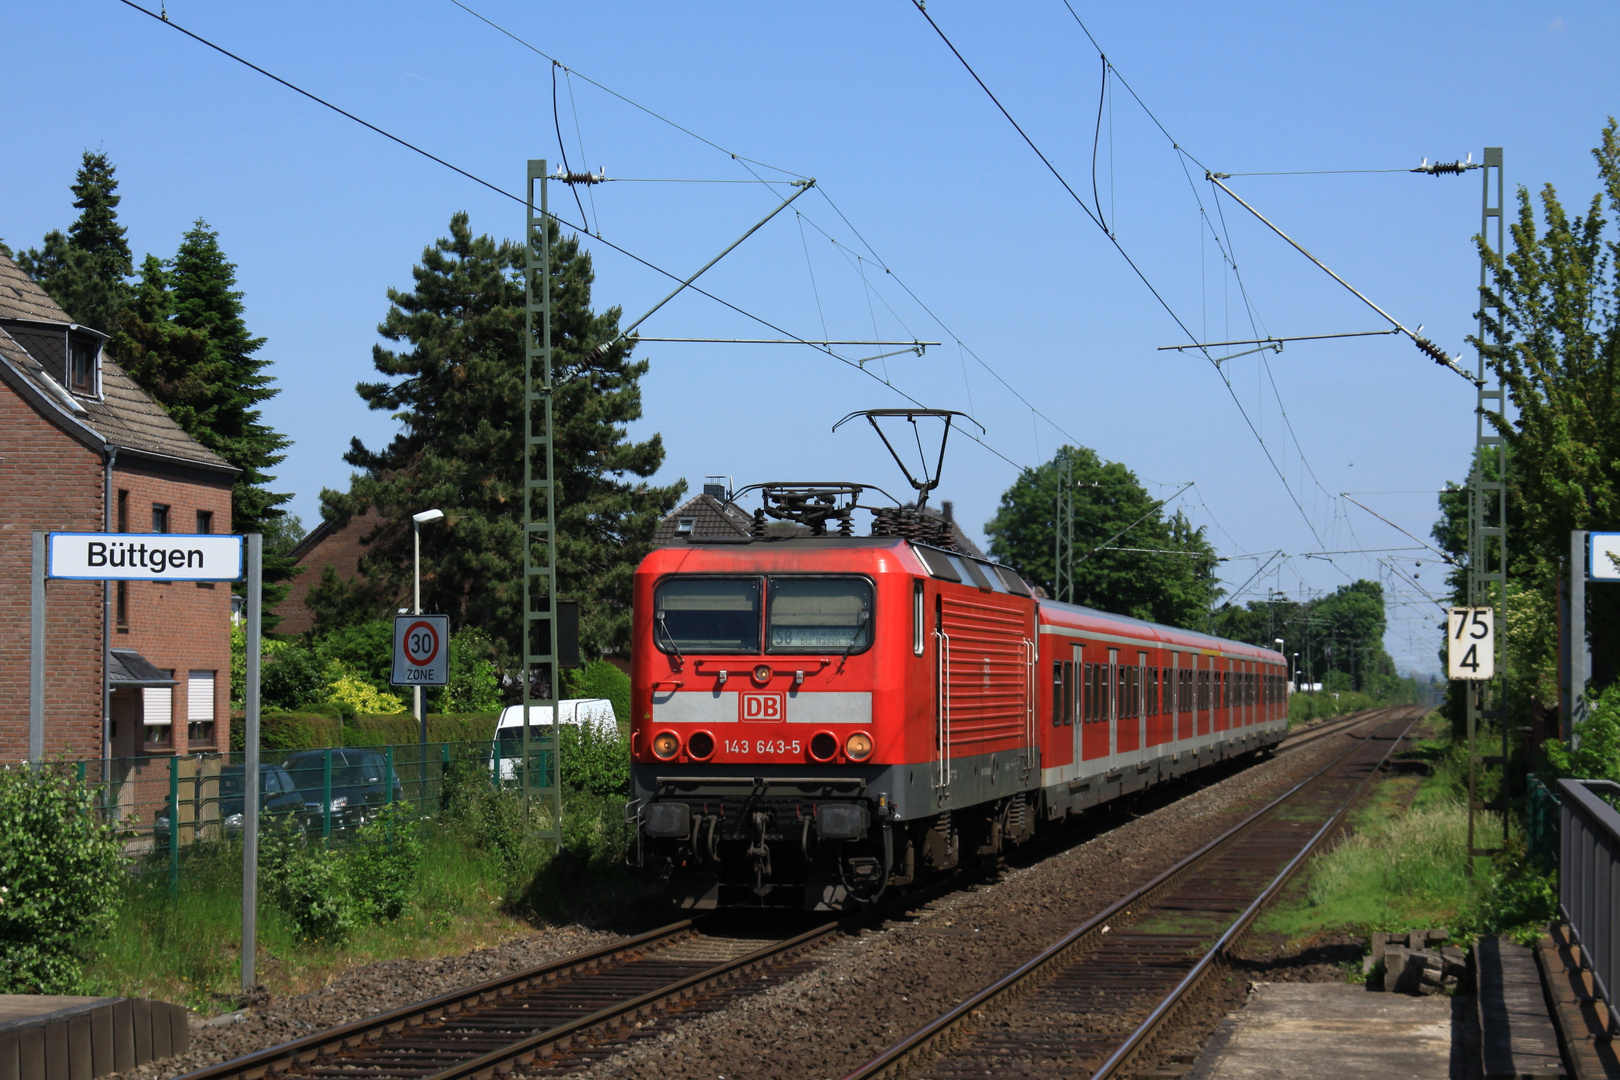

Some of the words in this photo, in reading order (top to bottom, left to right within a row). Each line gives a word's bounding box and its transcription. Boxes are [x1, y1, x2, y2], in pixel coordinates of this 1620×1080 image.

[87, 541, 204, 573] Büttgen
[1453, 610, 1489, 640] 75
[410, 633, 432, 654] 30
[775, 628, 793, 645] S8
[1459, 643, 1480, 673] 4
[406, 668, 435, 681] ZONE
[746, 696, 779, 718] DB
[724, 739, 750, 754] 143
[756, 739, 801, 754] 643-5
